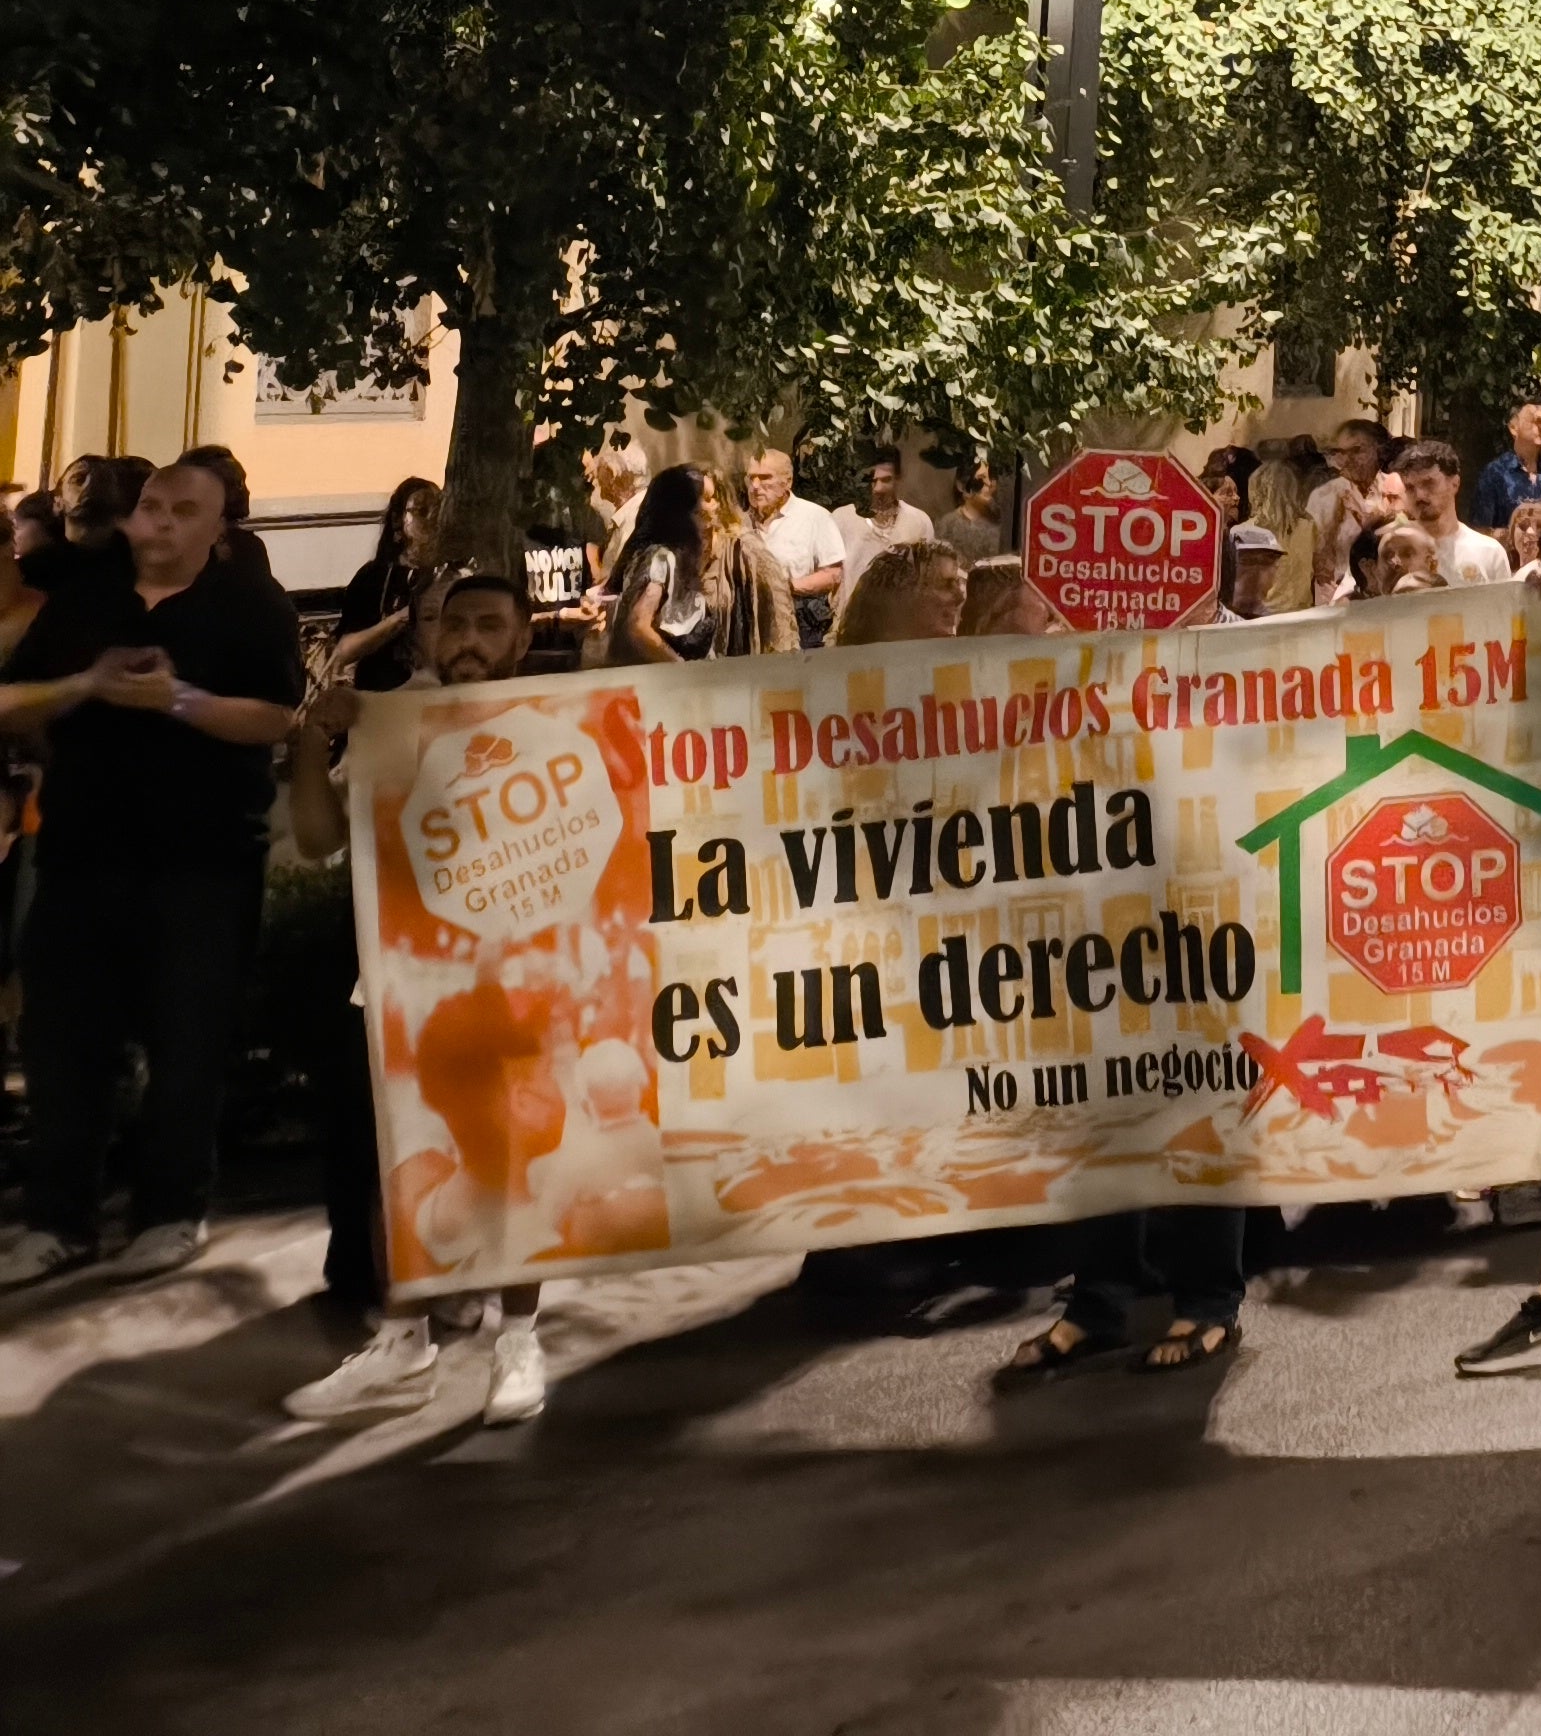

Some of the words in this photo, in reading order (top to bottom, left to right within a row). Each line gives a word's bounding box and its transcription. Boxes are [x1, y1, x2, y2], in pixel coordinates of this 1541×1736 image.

[1038, 504, 1208, 556] STOP
[1060, 583, 1180, 611] Granada
[1126, 611, 1145, 630] M
[600, 695, 749, 791] Stop
[771, 679, 1111, 776] Desahucios
[1132, 652, 1394, 732] Granada
[1415, 637, 1528, 711] 15M
[420, 752, 583, 862] STOP
[465, 847, 590, 912] Granada
[646, 828, 749, 924] La
[780, 780, 1156, 910] vivienda
[1340, 848, 1507, 909] STOP
[510, 896, 534, 923] 15
[543, 885, 562, 907] M
[1364, 931, 1485, 964] Granada
[1432, 959, 1450, 983] M
[652, 975, 741, 1063] es
[774, 960, 887, 1051] un
[918, 910, 1256, 1031] derecho
[966, 1063, 1017, 1115] No
[1033, 1060, 1088, 1108] un
[1105, 1040, 1260, 1098] negocio
